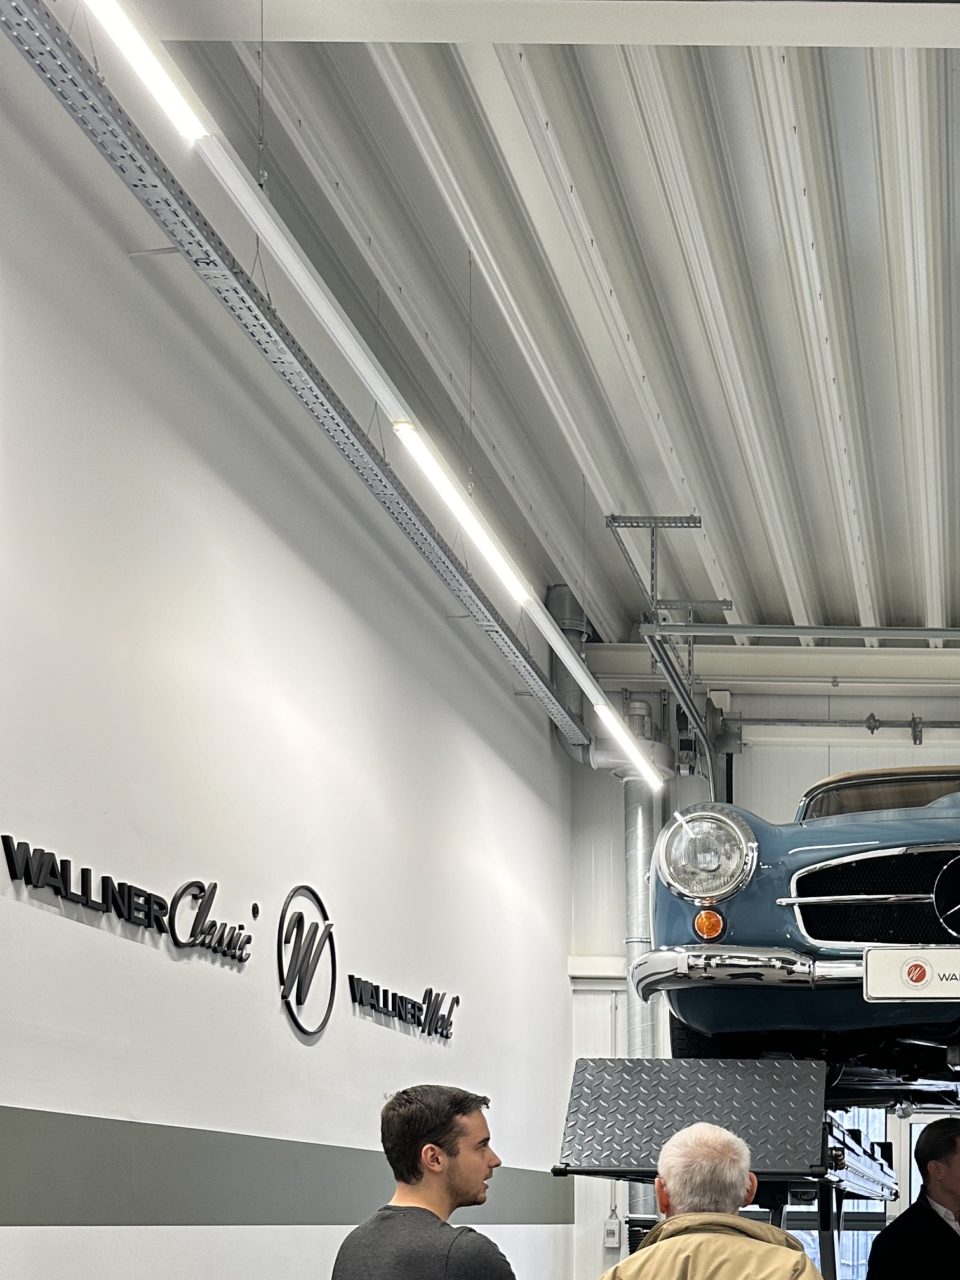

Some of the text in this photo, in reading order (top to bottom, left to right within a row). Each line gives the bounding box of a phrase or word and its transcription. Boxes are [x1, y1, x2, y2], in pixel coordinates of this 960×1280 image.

[1, 834, 252, 963] WALLNER Classic
[348, 974, 423, 1027] WALLNER
